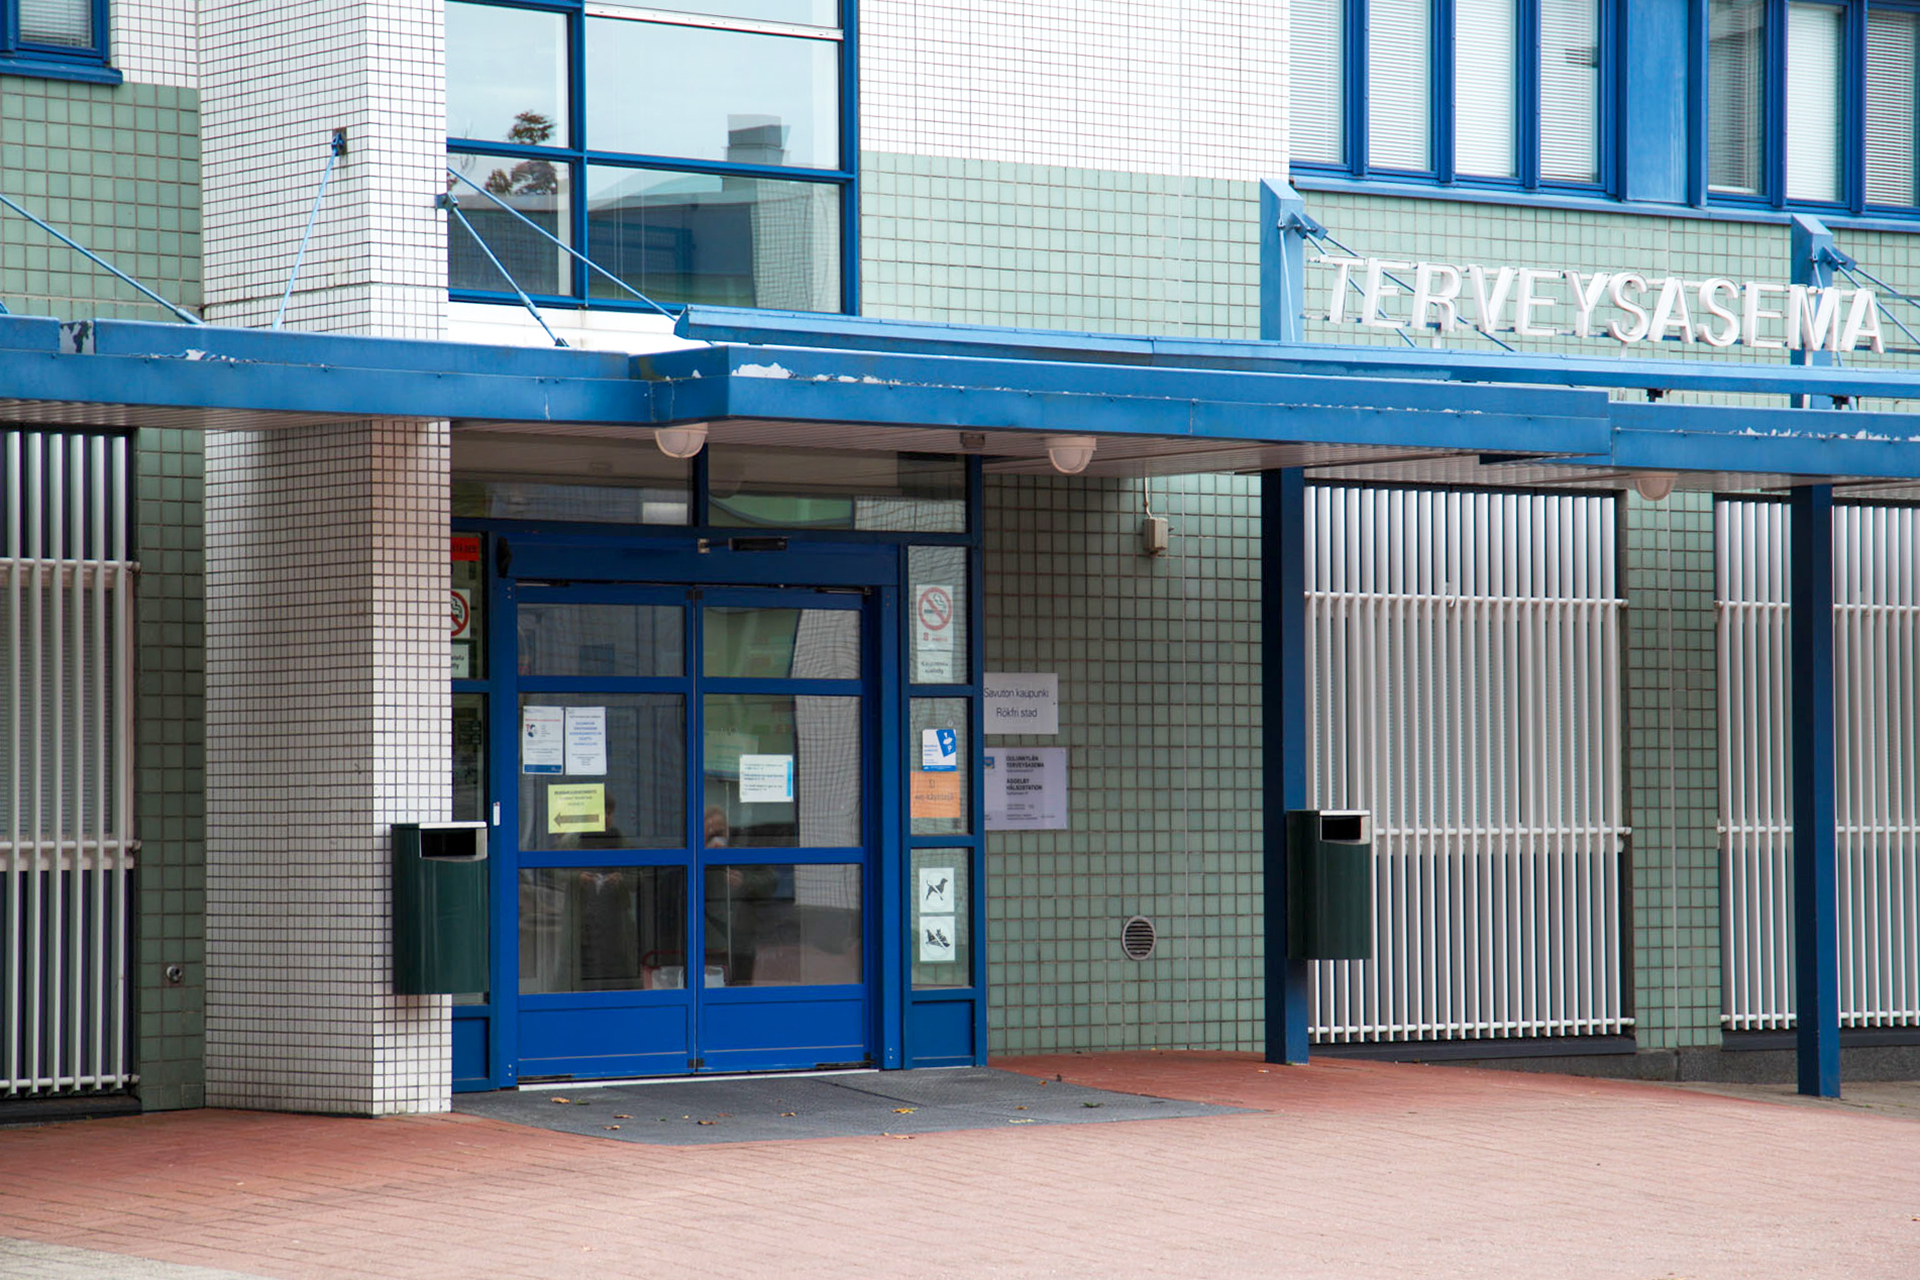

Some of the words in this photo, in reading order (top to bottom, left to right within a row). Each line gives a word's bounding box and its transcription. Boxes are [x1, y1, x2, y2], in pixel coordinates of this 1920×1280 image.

[1321, 255, 1886, 354] TERVEYSASEMA
[984, 687, 1015, 699] Savuton
[1016, 687, 1050, 701] kaupunki
[996, 707, 1019, 718] Rökfri
[1020, 708, 1038, 718] stad
